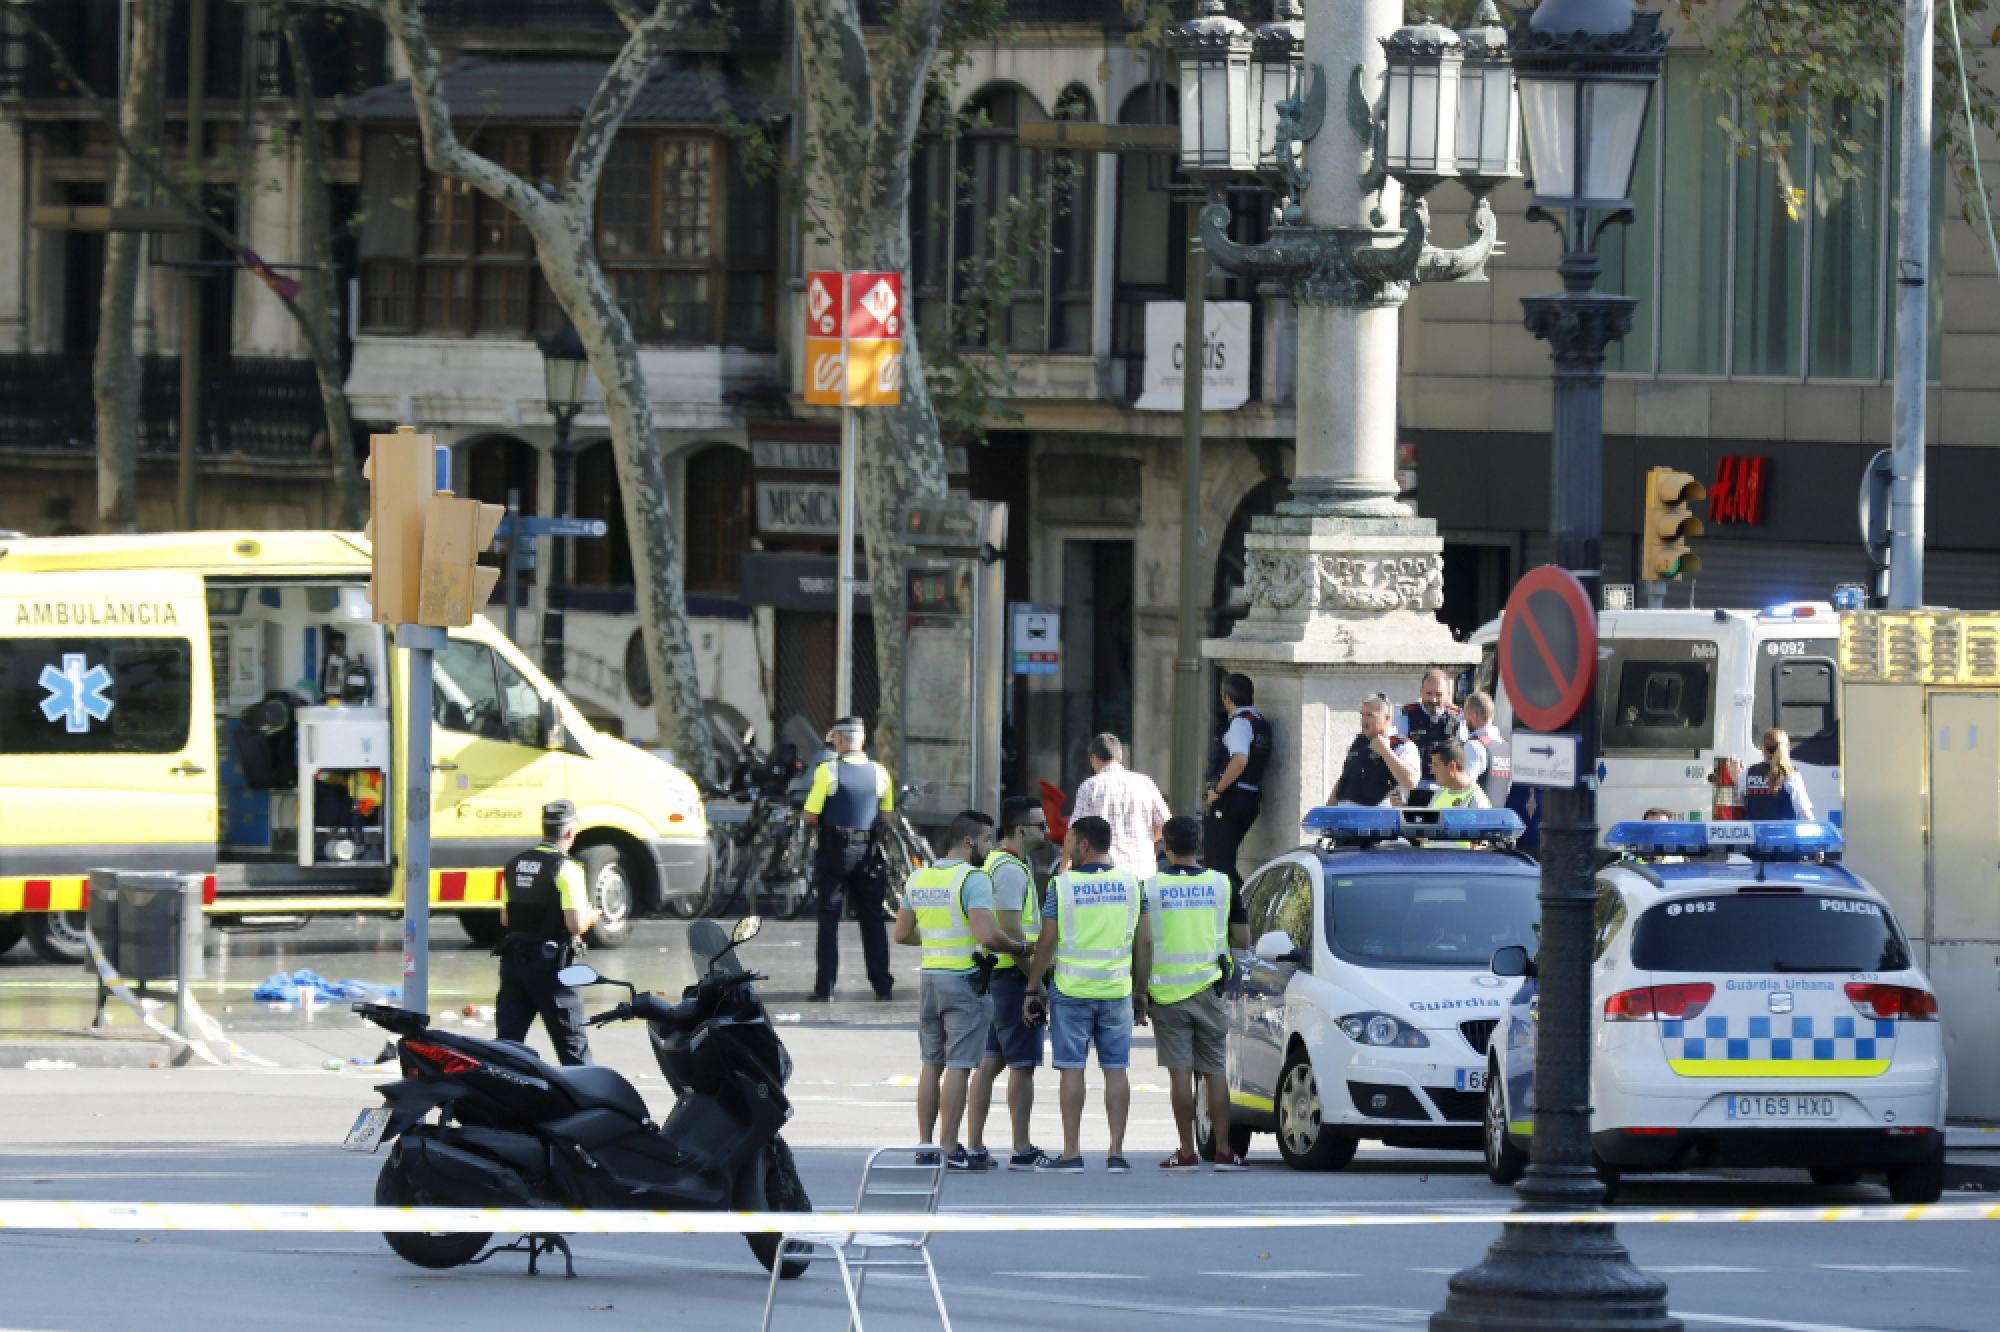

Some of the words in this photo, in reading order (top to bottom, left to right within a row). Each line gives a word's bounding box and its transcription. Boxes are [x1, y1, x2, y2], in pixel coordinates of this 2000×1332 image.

[1780, 641, 1805, 655] 092
[1709, 827, 1750, 840] POLICIA
[1073, 881, 1126, 896] POLICIA
[1160, 885, 1215, 900] POLICIA
[1685, 901, 1716, 913] 092
[1820, 900, 1881, 916] POLICIA
[1785, 979, 1835, 991] Urbana
[1739, 1098, 1790, 1116] 0169
[1797, 1098, 1833, 1116] HXD
